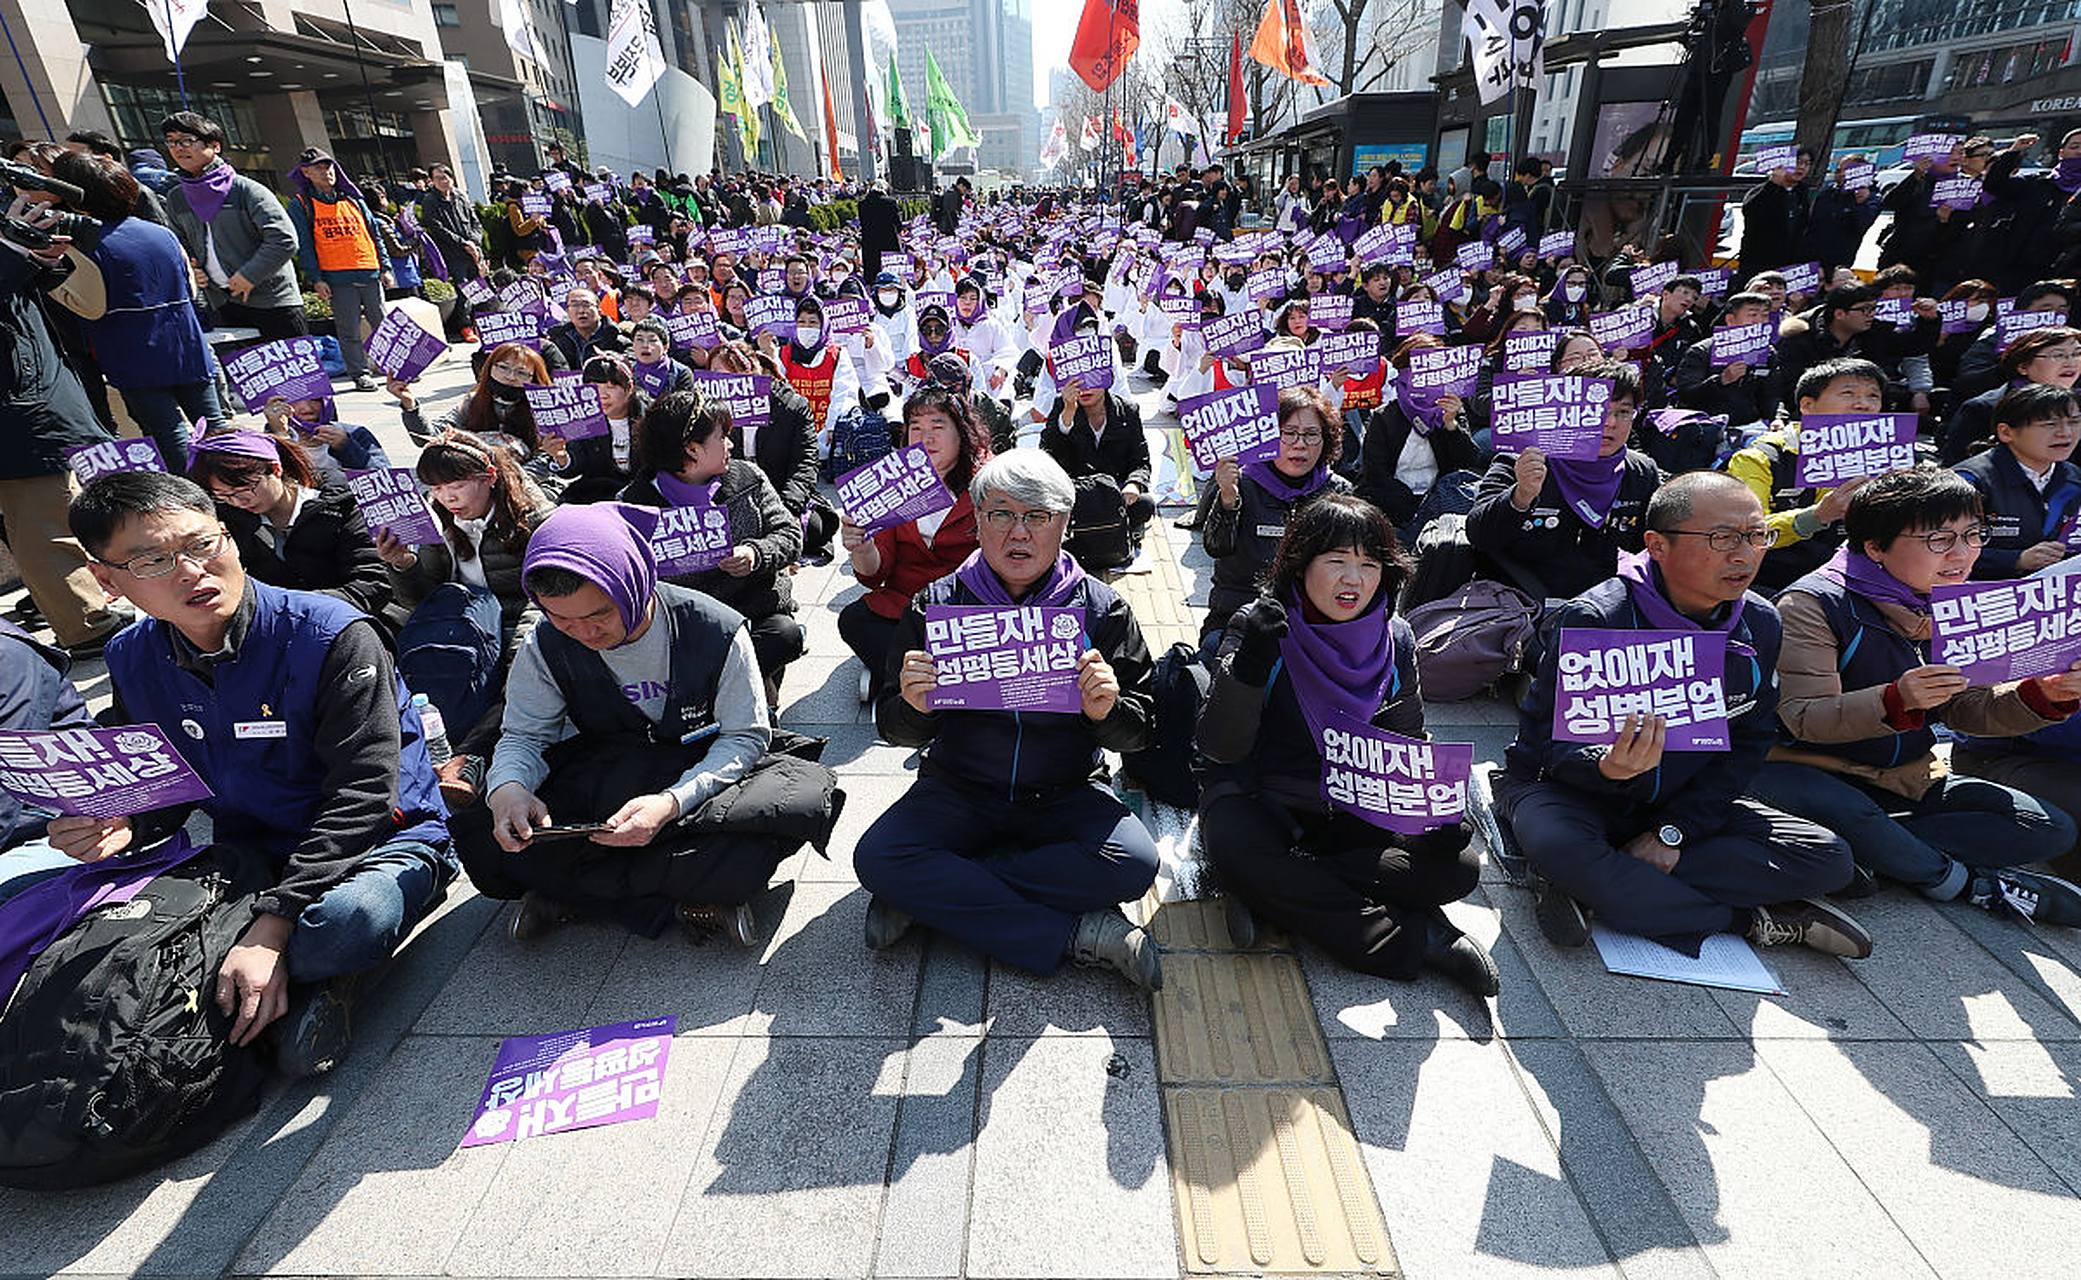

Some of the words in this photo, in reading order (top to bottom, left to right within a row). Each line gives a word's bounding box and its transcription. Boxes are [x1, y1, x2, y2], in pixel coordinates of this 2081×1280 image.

[1492, 375, 1582, 410] 만들자!
[1495, 403, 1604, 434] 성평등세상
[1800, 416, 1896, 455] 없애자!
[1931, 575, 2067, 636] 만들자!
[926, 606, 1045, 656] 만들자!
[937, 640, 1079, 686] 성평등세상
[1559, 636, 1696, 691] 없애자!
[1564, 677, 1728, 735] 성별분업
[1323, 728, 1436, 779] 없애자!
[1327, 766, 1467, 817] 성별분업
